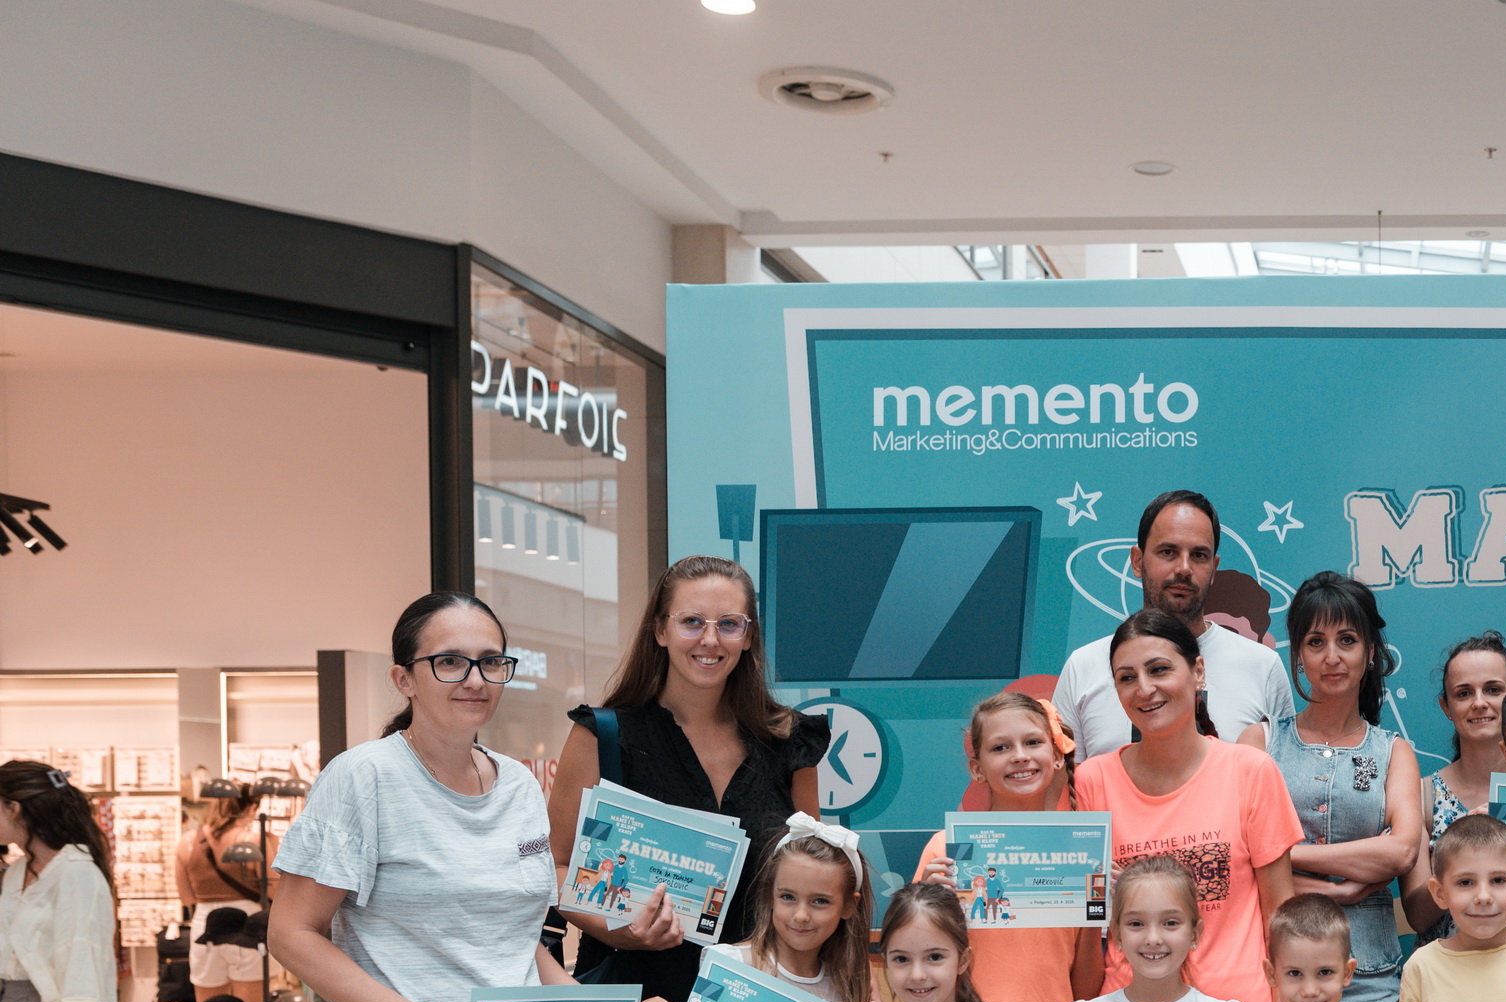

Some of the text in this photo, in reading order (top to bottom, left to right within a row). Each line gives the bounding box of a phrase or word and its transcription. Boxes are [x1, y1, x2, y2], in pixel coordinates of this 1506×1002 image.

[471, 339, 627, 462] PARFOIS
[873, 372, 1199, 427] memento
[873, 427, 1198, 455] Marketing&Communications
[705, 839, 733, 852] memento
[1119, 836, 1178, 856] BREATHE
[1183, 834, 1196, 845] IN
[1202, 830, 1222, 841] MY
[618, 837, 716, 877] ZAHVALNICU
[986, 851, 1088, 864] ZAHVALNICU
[700, 917, 715, 927] BIG
